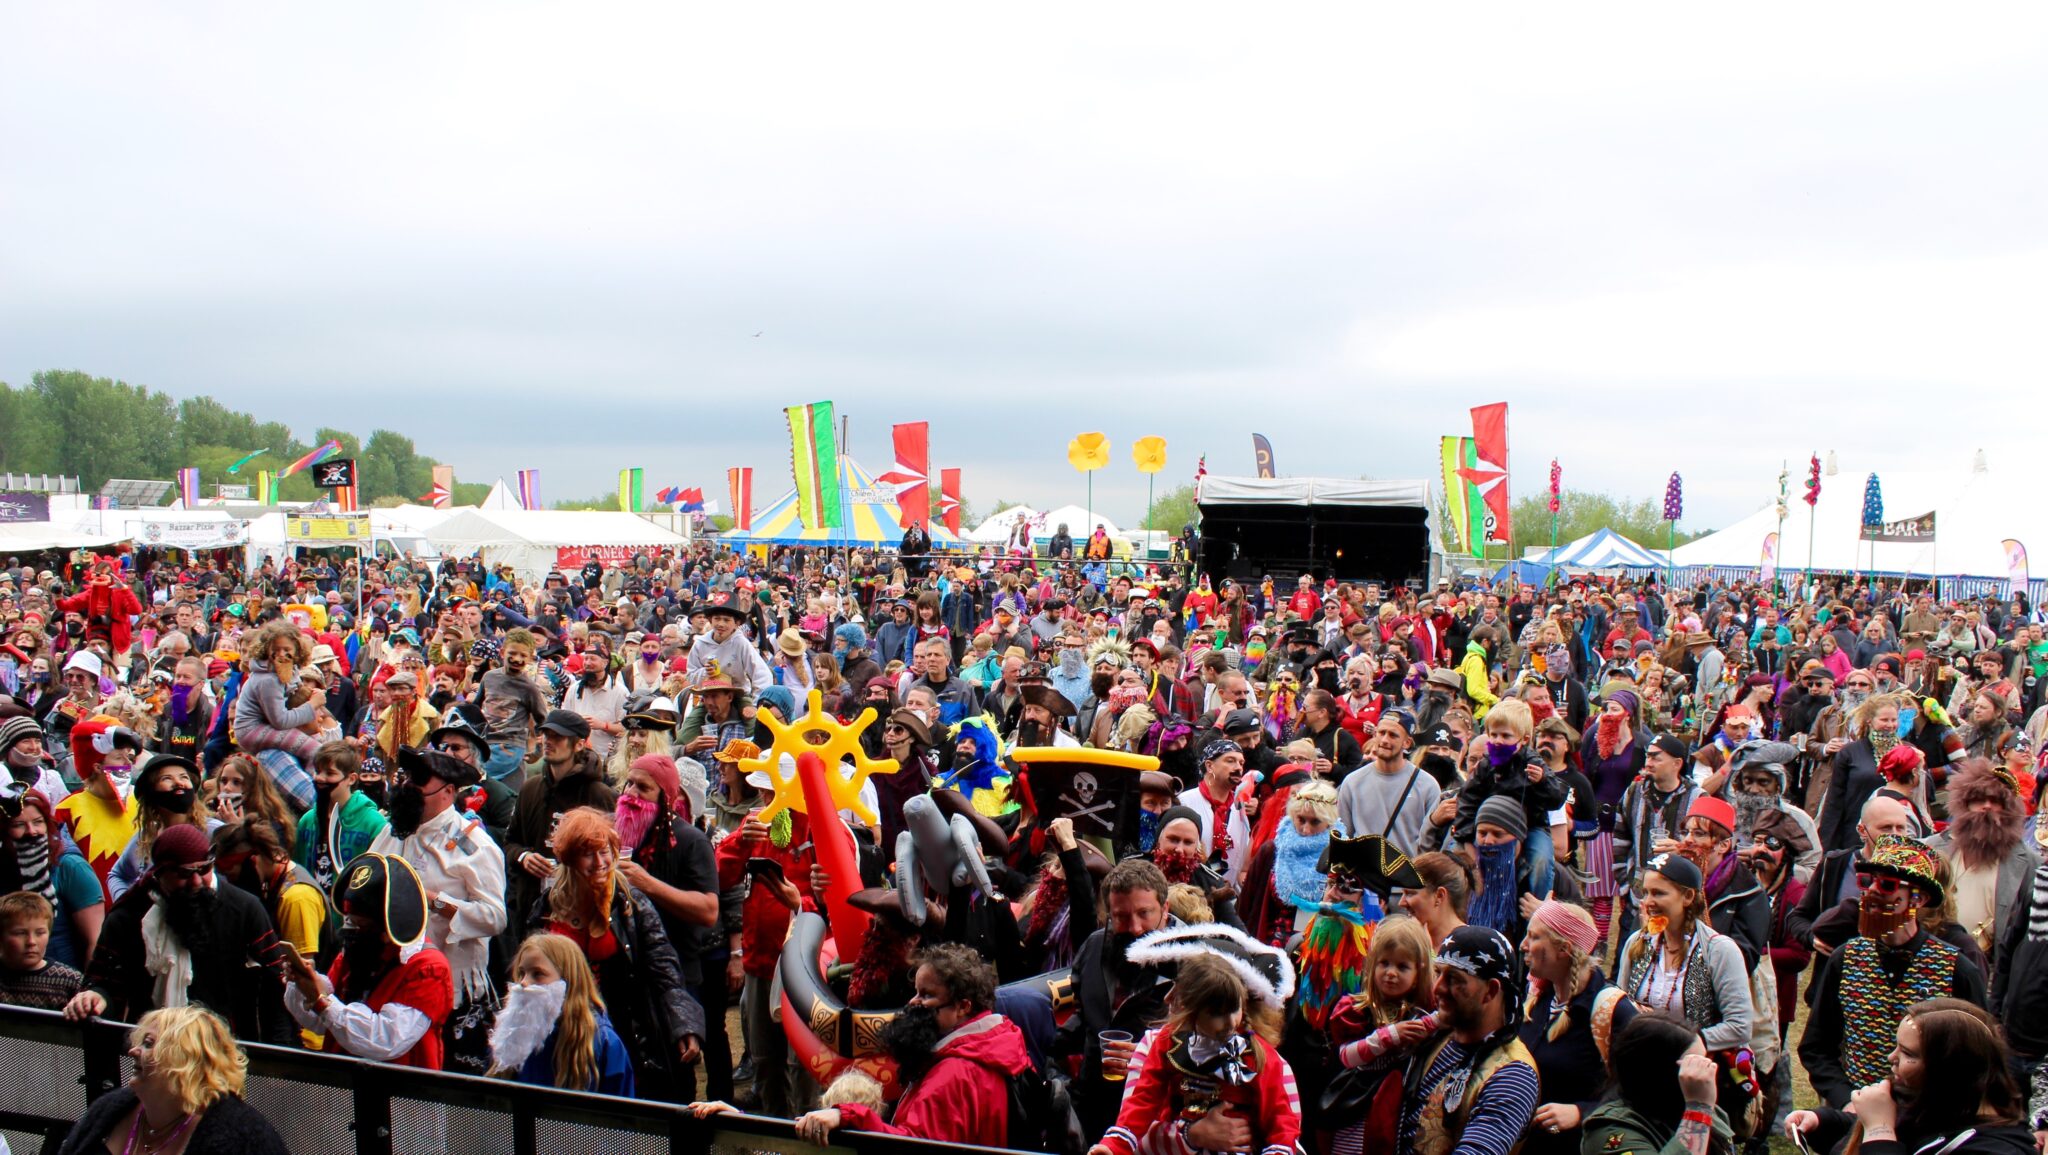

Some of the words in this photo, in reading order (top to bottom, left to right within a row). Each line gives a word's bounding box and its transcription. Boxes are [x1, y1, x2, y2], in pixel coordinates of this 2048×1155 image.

[1883, 520, 1919, 537] BAR
[580, 547, 625, 559] CORNER
[628, 547, 656, 559] SP
